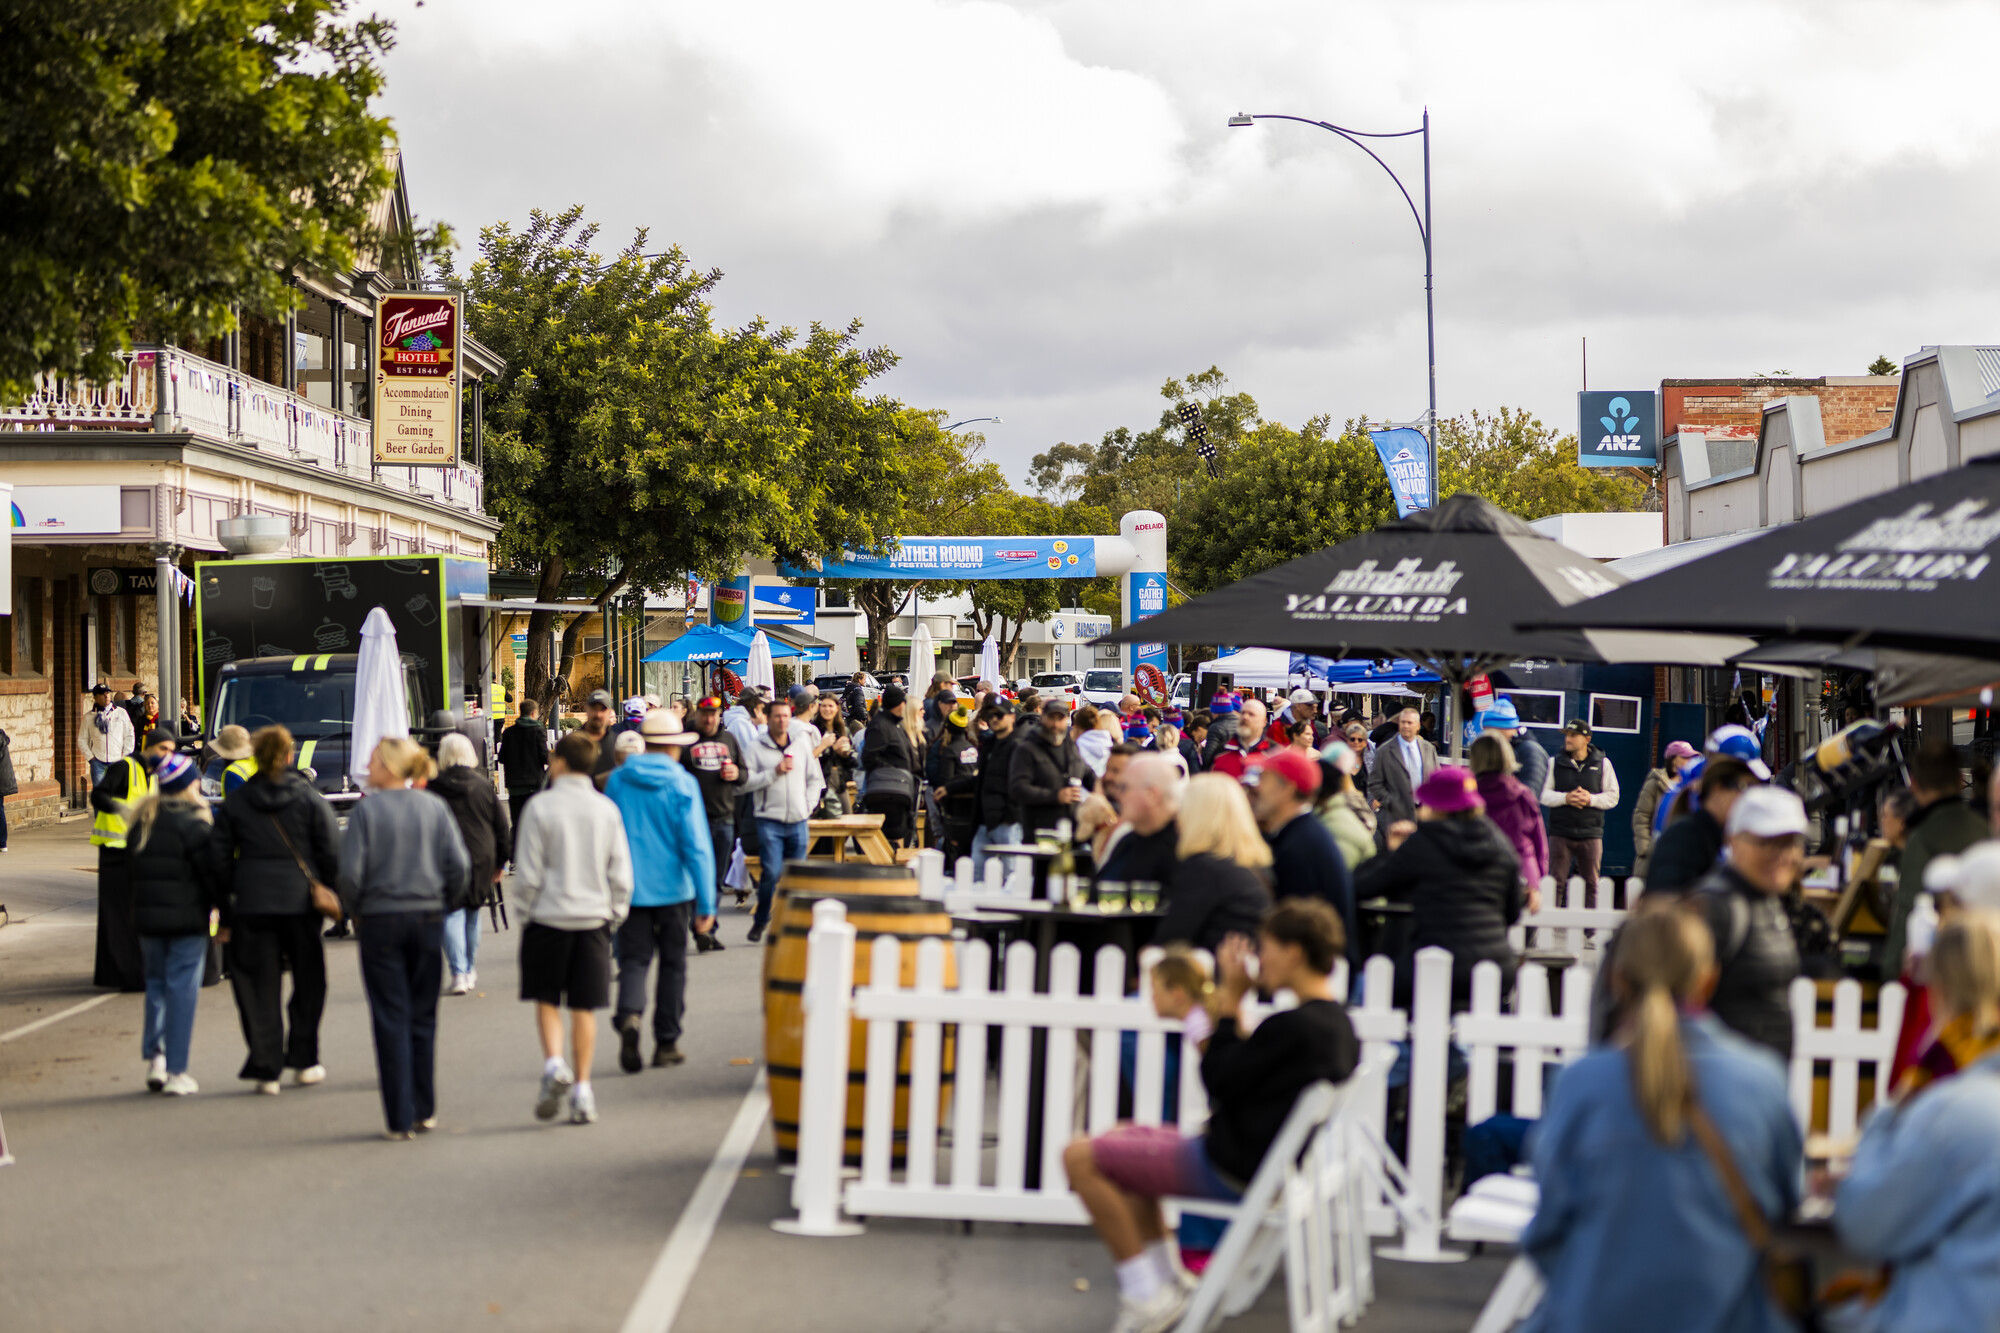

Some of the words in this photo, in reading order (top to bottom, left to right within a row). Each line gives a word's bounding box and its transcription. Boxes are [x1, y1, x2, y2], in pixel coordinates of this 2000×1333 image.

[383, 305, 450, 346] Tanunda
[397, 352, 437, 363] HOTEL
[396, 366, 413, 374] EST
[418, 367, 438, 375] 1846
[384, 387, 449, 399] Accommodation
[400, 405, 432, 420] Dining
[397, 424, 434, 438] Gaming
[386, 442, 407, 454] Beer
[411, 442, 444, 454] Garden
[1596, 434, 1641, 451] ANZ
[1134, 522, 1164, 532] ADELAIDE
[939, 545, 983, 563] ROUND
[716, 588, 743, 600] BAROSSA
[1138, 587, 1164, 599] GATHER
[1140, 599, 1163, 610] ROUND
[1284, 593, 1468, 614] YALUMBA
[1075, 621, 1098, 638] BAROSSA
[687, 651, 723, 660] HAHN
